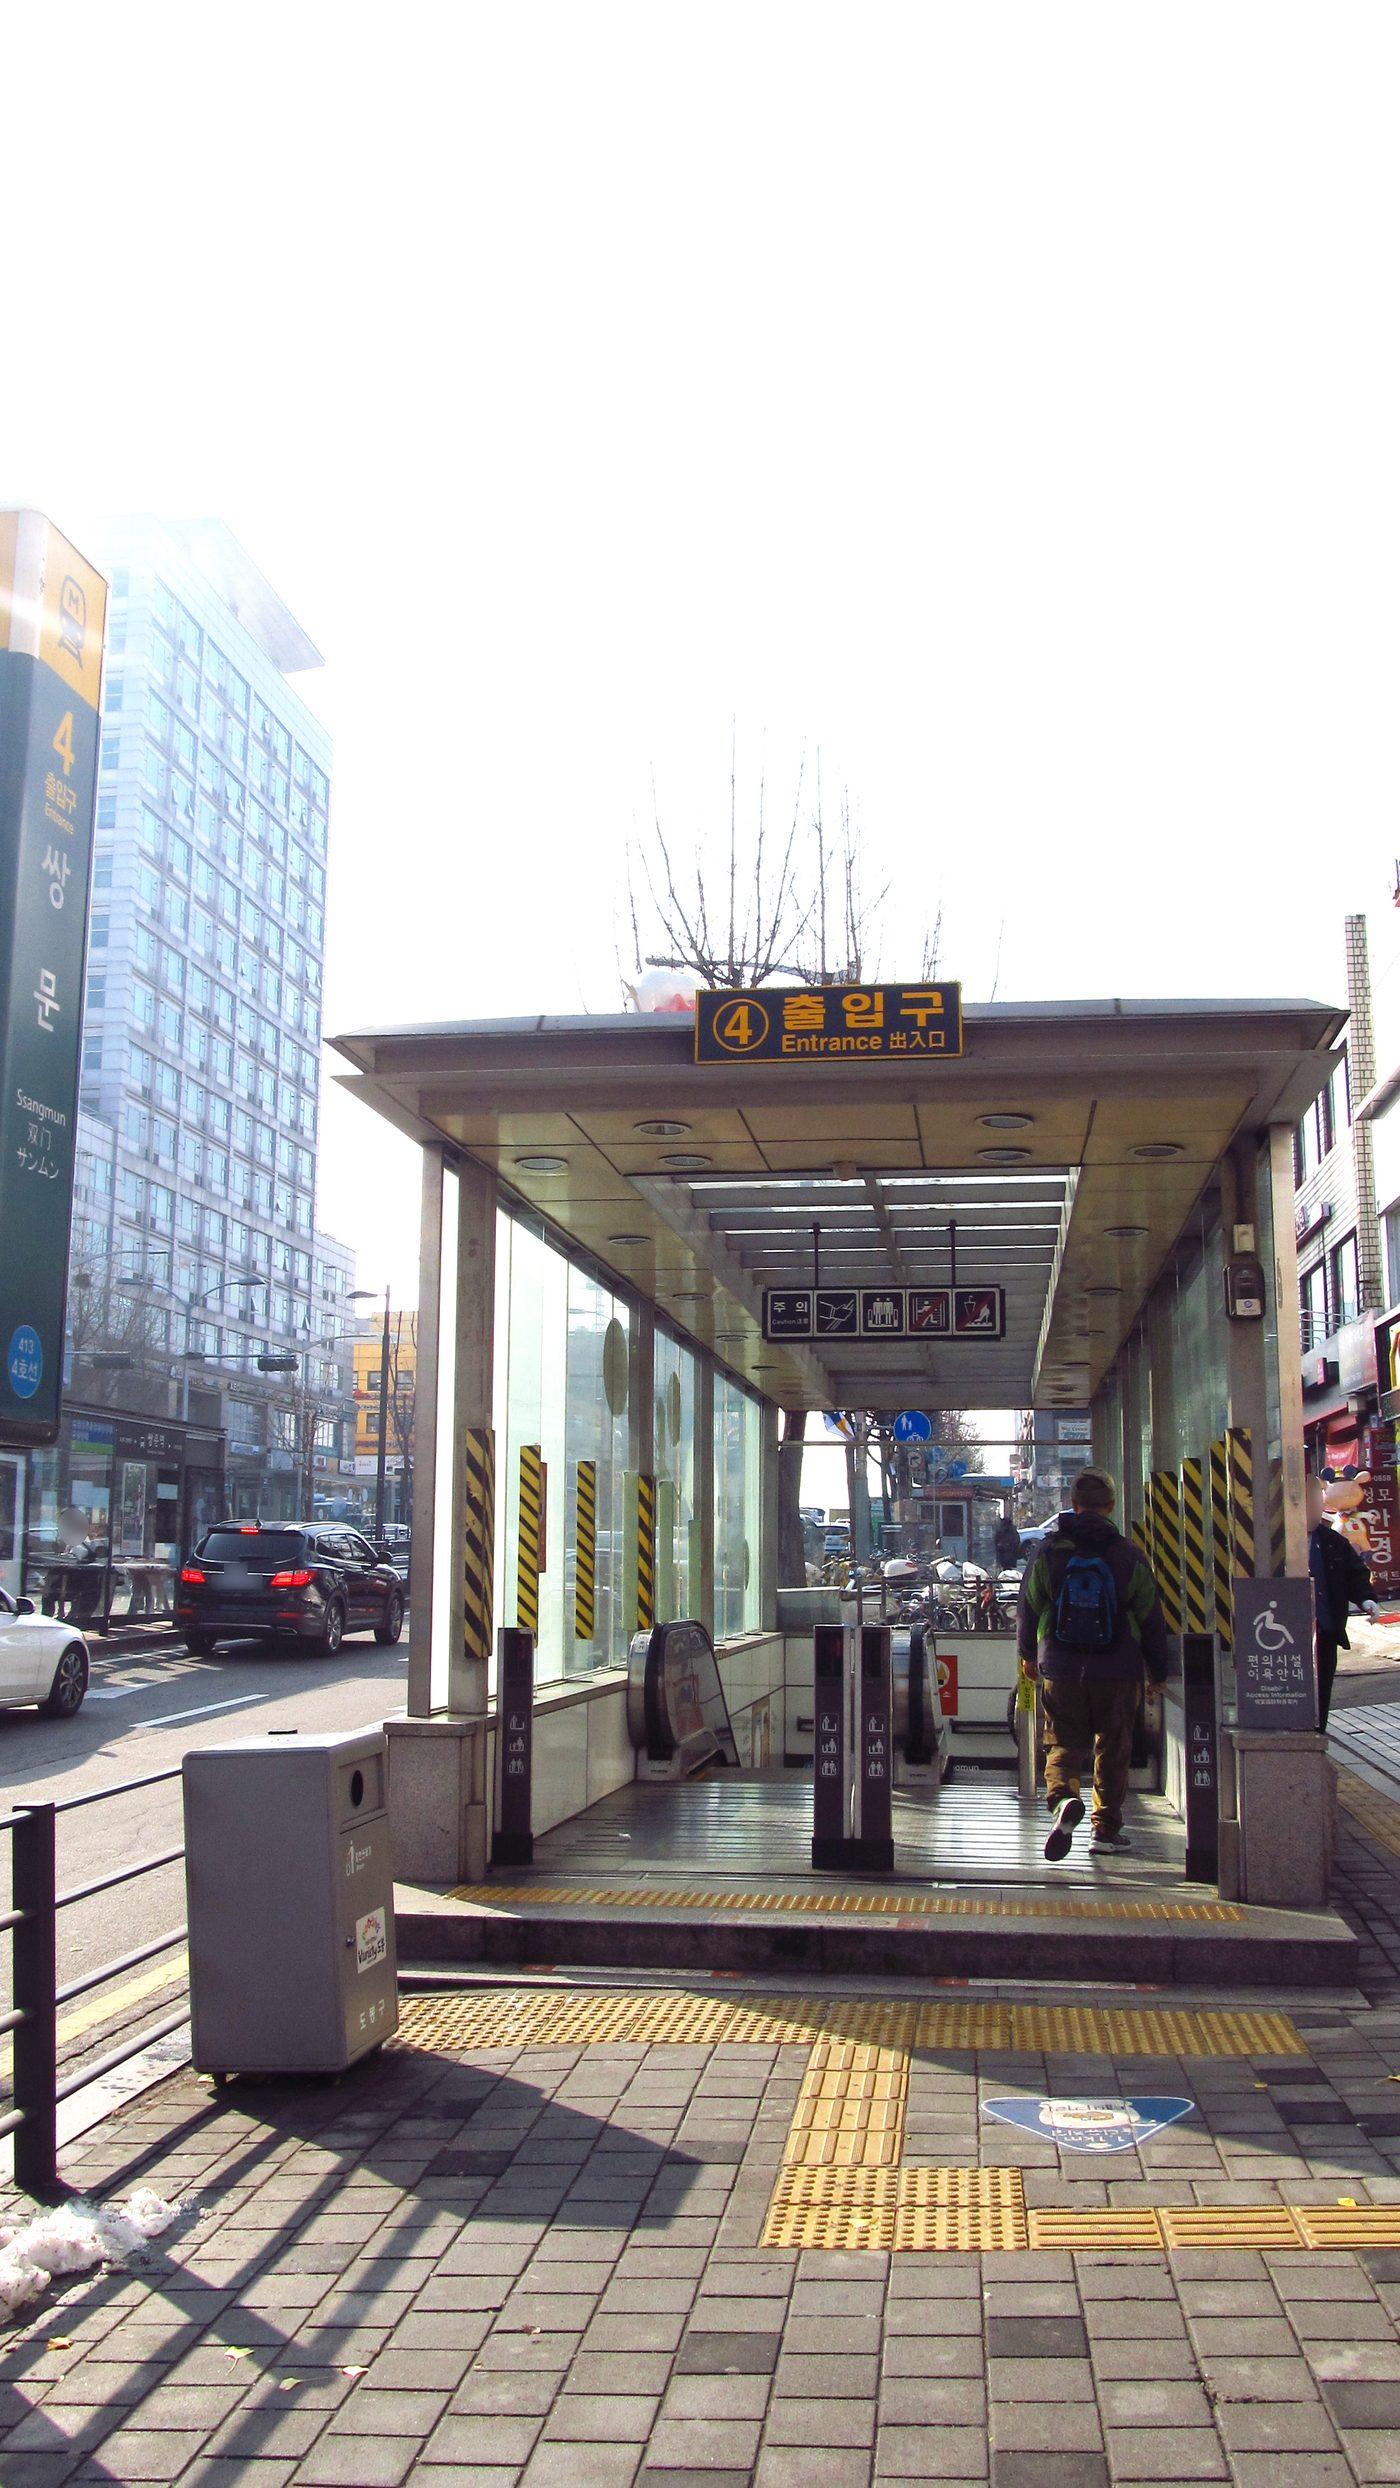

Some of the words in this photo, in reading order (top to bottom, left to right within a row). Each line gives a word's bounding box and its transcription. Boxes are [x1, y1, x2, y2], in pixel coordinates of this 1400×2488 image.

[52, 711, 76, 776] 4
[44, 771, 77, 815] 출입구
[782, 990, 945, 1031] 출입구
[781, 1034, 883, 1053] Entrance
[889, 1030, 945, 1050] 出入口
[16, 1087, 67, 1127] Ssangmun
[773, 1301, 808, 1313] 주의
[18, 1338, 34, 1354] 413
[11, 1358, 38, 1382] 4호선
[1368, 1508, 1393, 1563] 안경
[1247, 1654, 1302, 1668] 편의시설
[359, 1998, 386, 2031] 도봉구
